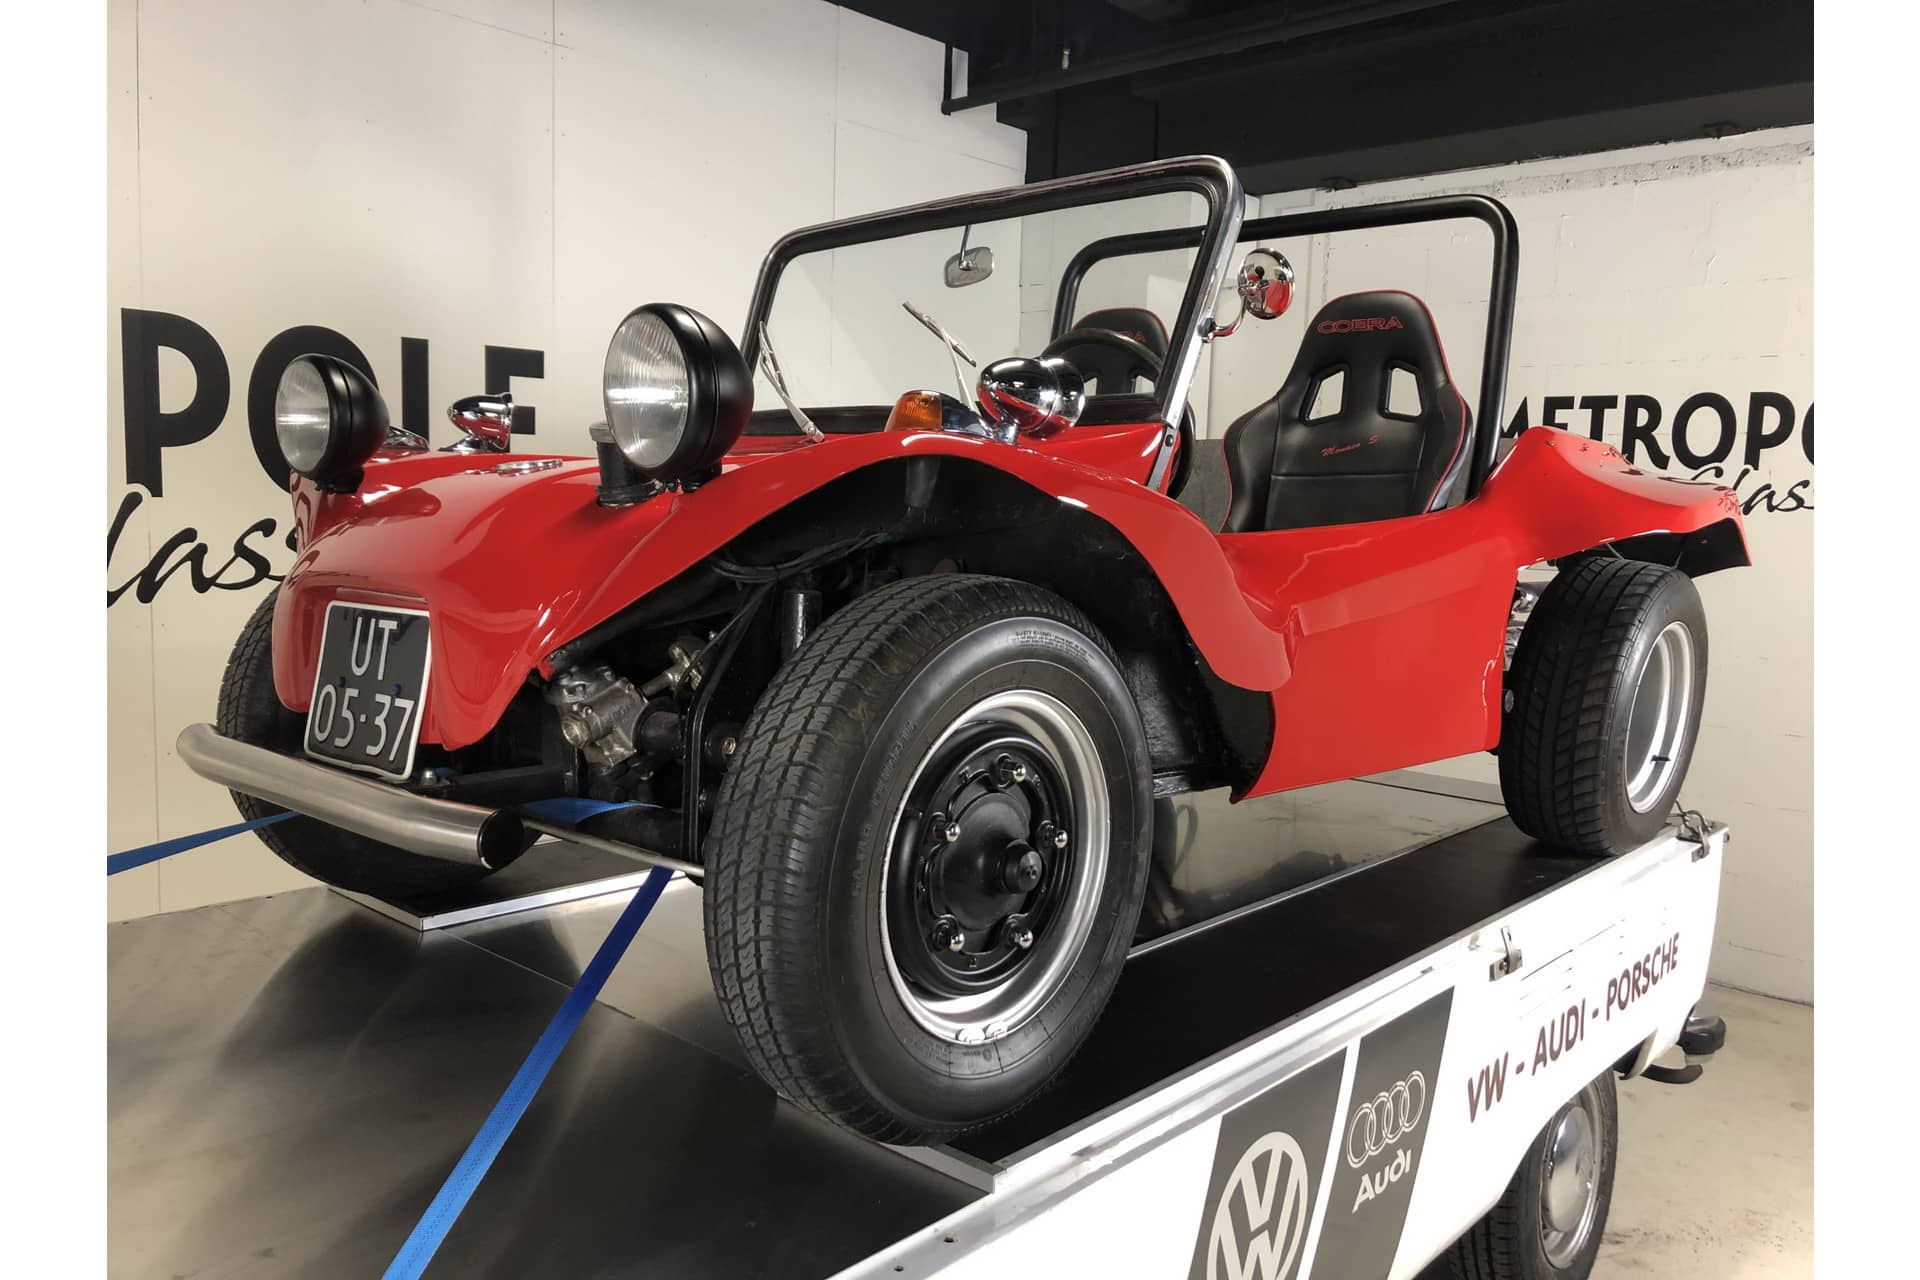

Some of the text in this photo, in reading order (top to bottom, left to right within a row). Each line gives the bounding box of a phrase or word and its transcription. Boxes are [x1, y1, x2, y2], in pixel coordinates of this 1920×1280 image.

[1317, 315, 1404, 334] COBRA
[1500, 391, 1814, 470] ETROP
[351, 616, 398, 680] UT
[1467, 1051, 1509, 1123] VW
[1532, 997, 1585, 1076] AUDI
[1606, 932, 1679, 1021] PORSCHE
[1352, 1148, 1411, 1213] Audi
